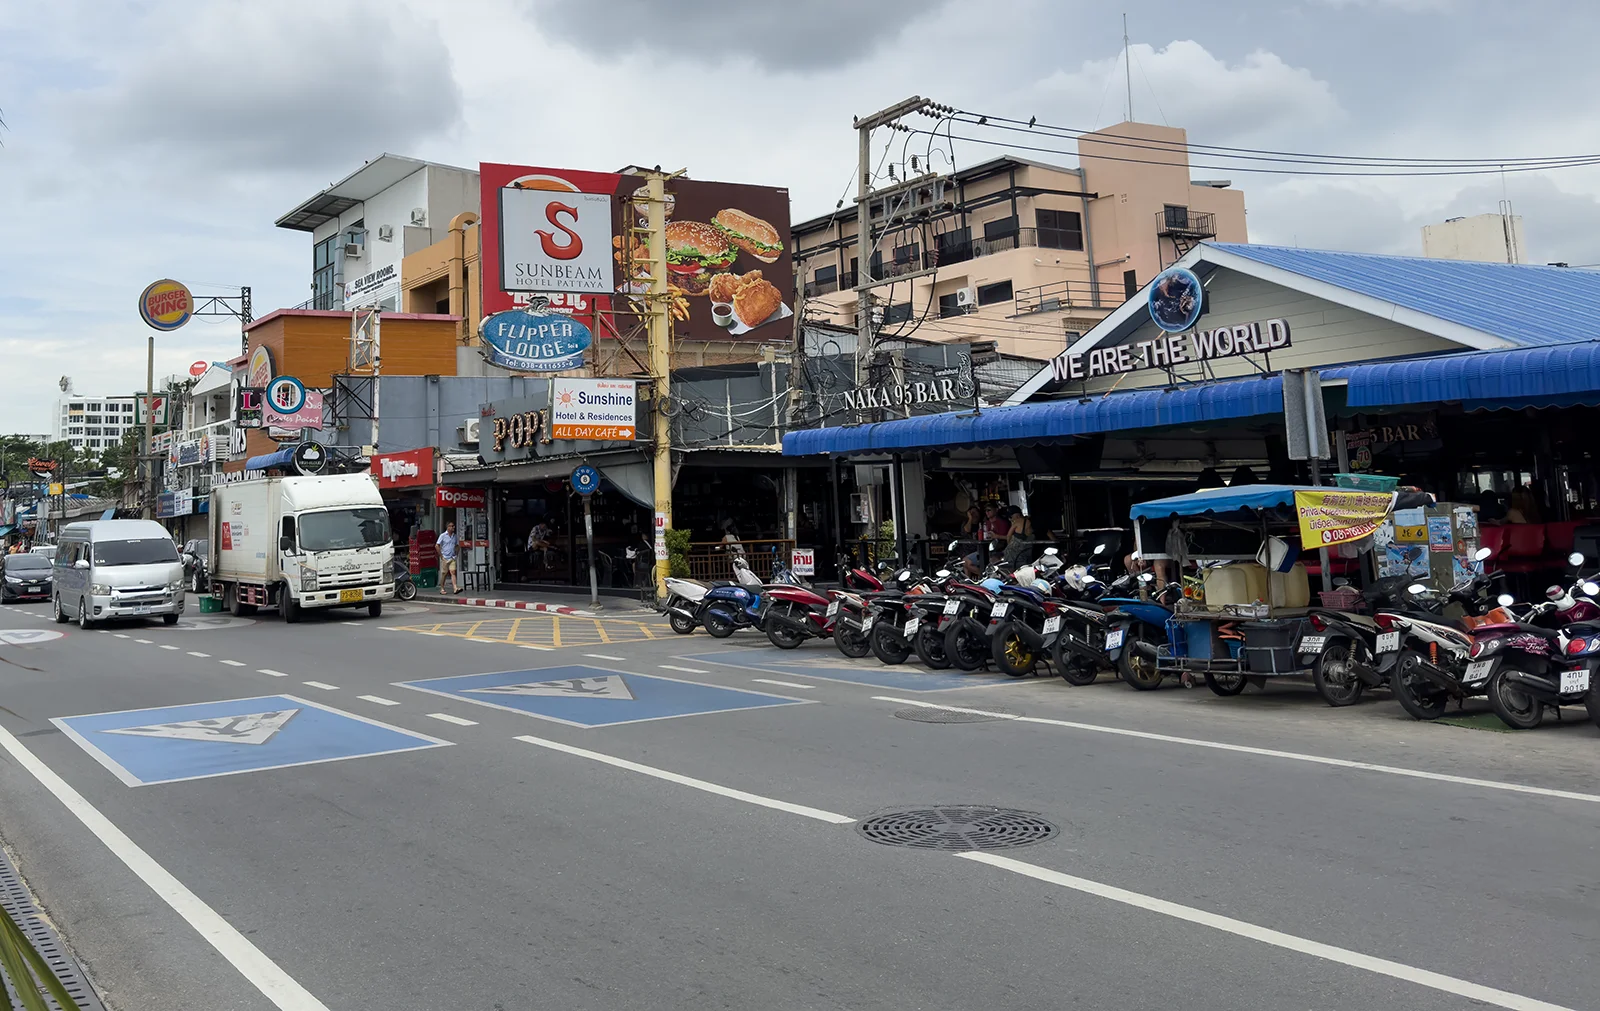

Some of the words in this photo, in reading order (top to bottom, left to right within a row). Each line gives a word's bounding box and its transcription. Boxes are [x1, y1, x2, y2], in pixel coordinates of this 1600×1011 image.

[354, 277, 364, 289] SEA
[364, 272, 376, 285] VIEW
[376, 264, 394, 280] ROOMS
[515, 263, 602, 280] SUNBEAM
[516, 279, 552, 287] HOTEL
[557, 280, 604, 289] PATTAYA
[148, 290, 186, 306] BURGER
[150, 299, 188, 318] KING
[498, 322, 572, 340] FLIPPER
[505, 340, 565, 359] LODGE
[1050, 352, 1084, 383] WE
[1089, 344, 1134, 377] ARE
[1136, 334, 1190, 368] THE
[1190, 318, 1291, 357] WORLD
[505, 358, 518, 368] Tel:
[578, 391, 632, 406] Sunshine
[843, 387, 891, 410] NAKA
[894, 384, 912, 405] 95
[915, 379, 956, 403] BAR
[556, 412, 576, 420] Hotel
[578, 412, 586, 420] &
[588, 412, 632, 422] Residences
[555, 426, 572, 437] ALL
[574, 427, 594, 437] DAY
[229, 426, 246, 454] HRS
[380, 458, 405, 482] Tops
[439, 490, 468, 504] Tops
[794, 552, 812, 564] ห้าม
[1525, 642, 1544, 650] Fino
[1564, 684, 1584, 692] 9015
